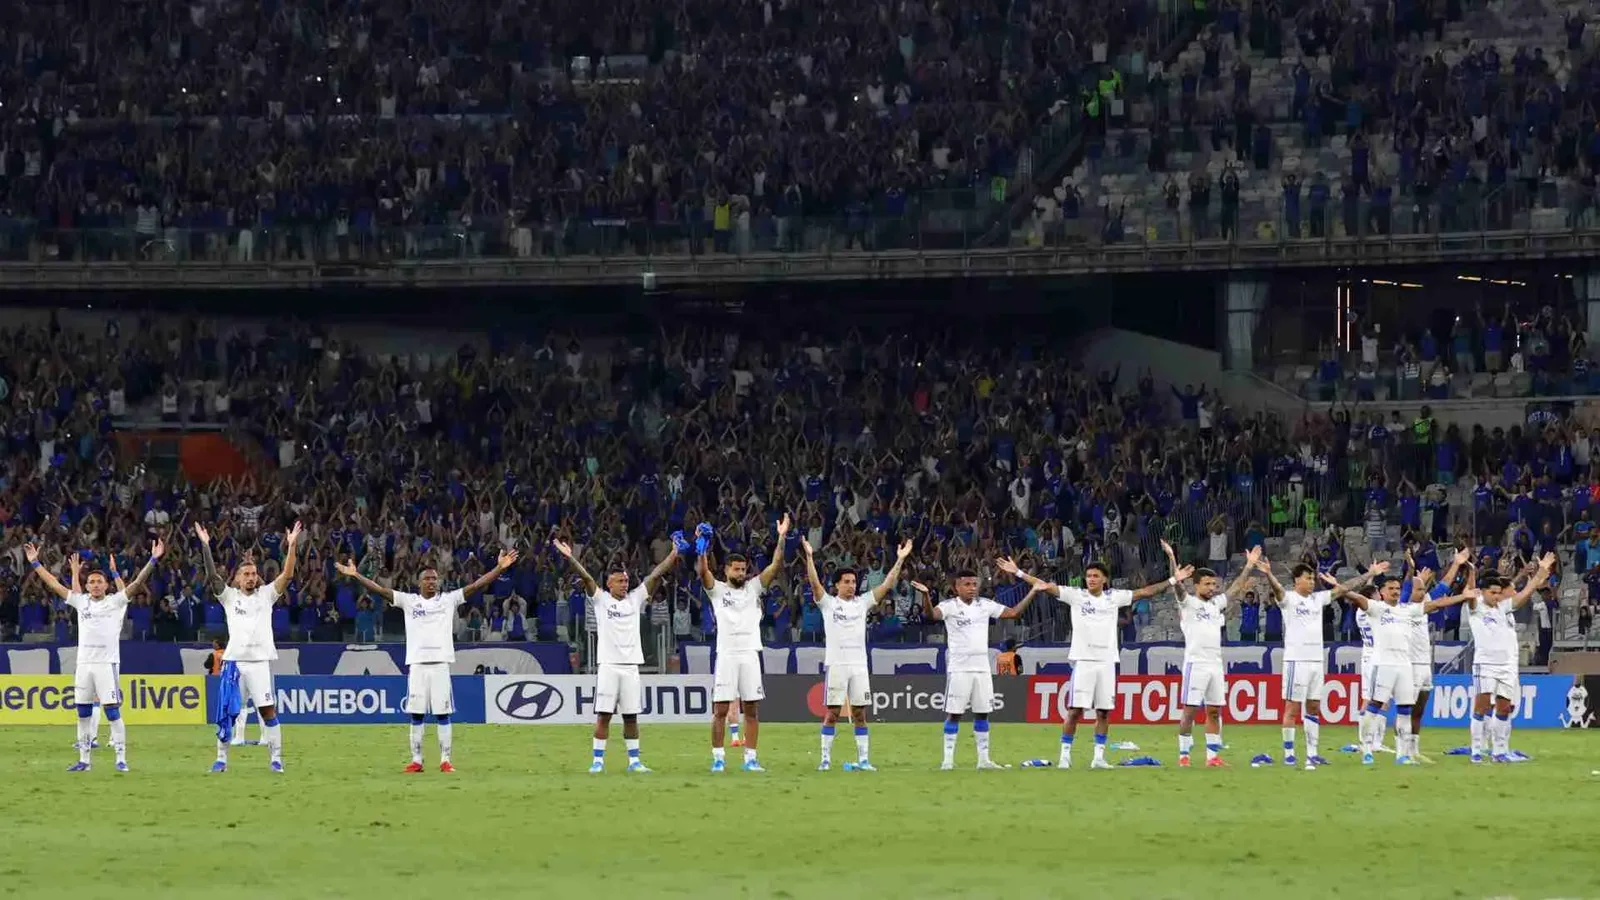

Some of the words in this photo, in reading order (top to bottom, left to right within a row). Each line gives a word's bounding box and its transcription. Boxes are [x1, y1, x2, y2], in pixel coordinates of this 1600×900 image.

[130, 679, 200, 710] livre
[1116, 680, 1183, 722] TCL
[1224, 680, 1279, 722] CL
